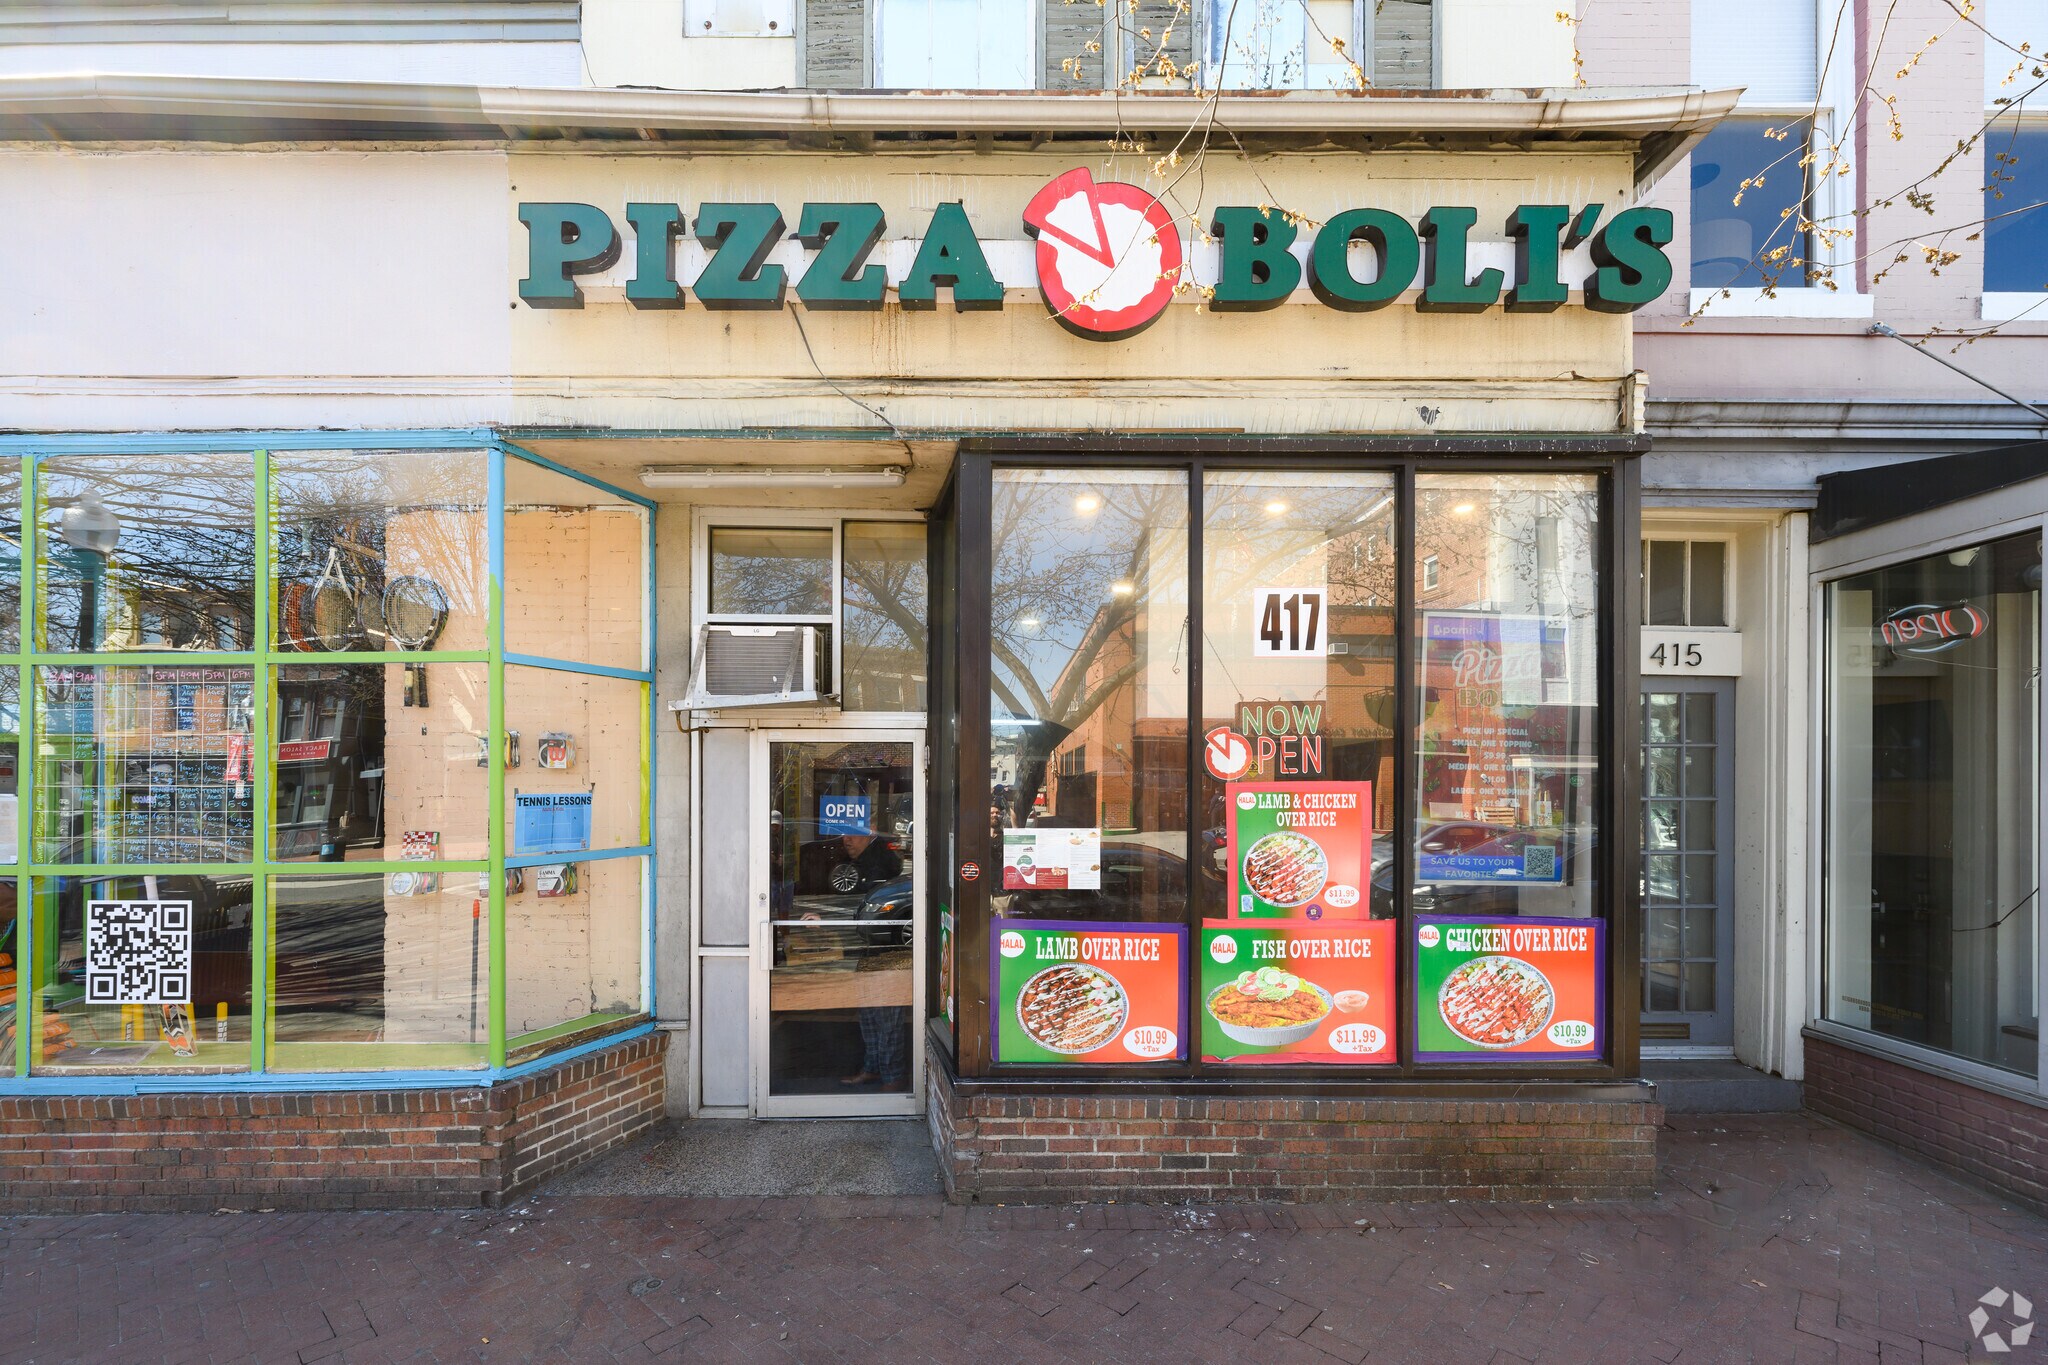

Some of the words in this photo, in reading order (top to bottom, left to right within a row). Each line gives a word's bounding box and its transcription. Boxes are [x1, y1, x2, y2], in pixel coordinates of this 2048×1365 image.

[518, 202, 1004, 311] PIZZA
[1209, 203, 1673, 314] BOLI'S
[1261, 594, 1321, 650] 417
[1649, 643, 1702, 668] 415
[1452, 648, 1542, 687] Pizza
[76, 671, 97, 681] 9AM
[204, 669, 226, 680] 5PM
[232, 670, 251, 680] 6PM
[1242, 704, 1322, 736] NOW
[1463, 727, 1482, 735] PICK
[1481, 739, 1497, 747] ONE
[1499, 739, 1533, 748] TOPPING
[517, 796, 551, 807] TENNIS
[553, 796, 592, 806] LESSONS
[1238, 796, 1256, 804] HALAL
[1258, 793, 1291, 809] LAMB
[1293, 794, 1301, 809] &
[1303, 793, 1357, 809] CHICKEN
[825, 803, 865, 818] OPEN
[1276, 811, 1307, 827] OVER
[1308, 812, 1337, 827] RICE
[1431, 857, 1456, 865] SAVE
[1458, 858, 1470, 866] US
[1473, 858, 1486, 866] TO
[1487, 859, 1515, 867] YOUR
[1445, 870, 1500, 879] FAVORITES
[1329, 889, 1355, 898] $11.99
[1419, 931, 1439, 941] HALAL
[1446, 928, 1511, 952] CHICKEN
[1513, 928, 1551, 952] OVER
[1553, 928, 1588, 952] RICE
[1000, 938, 1024, 949] HALAL
[1035, 937, 1079, 960] LAMB
[1081, 937, 1122, 961] OVER
[1123, 938, 1160, 961] RICE
[1211, 942, 1236, 954] HALAL
[1252, 940, 1287, 959] FISH
[1291, 939, 1332, 959] OVER
[1333, 938, 1372, 958] RICE
[1336, 1029, 1377, 1045] $11.99
[1553, 1024, 1587, 1038] $10.99
[1134, 1030, 1167, 1047] $10.99
[1142, 1045, 1160, 1054] +Tax
[1352, 1044, 1373, 1053] +Tax
